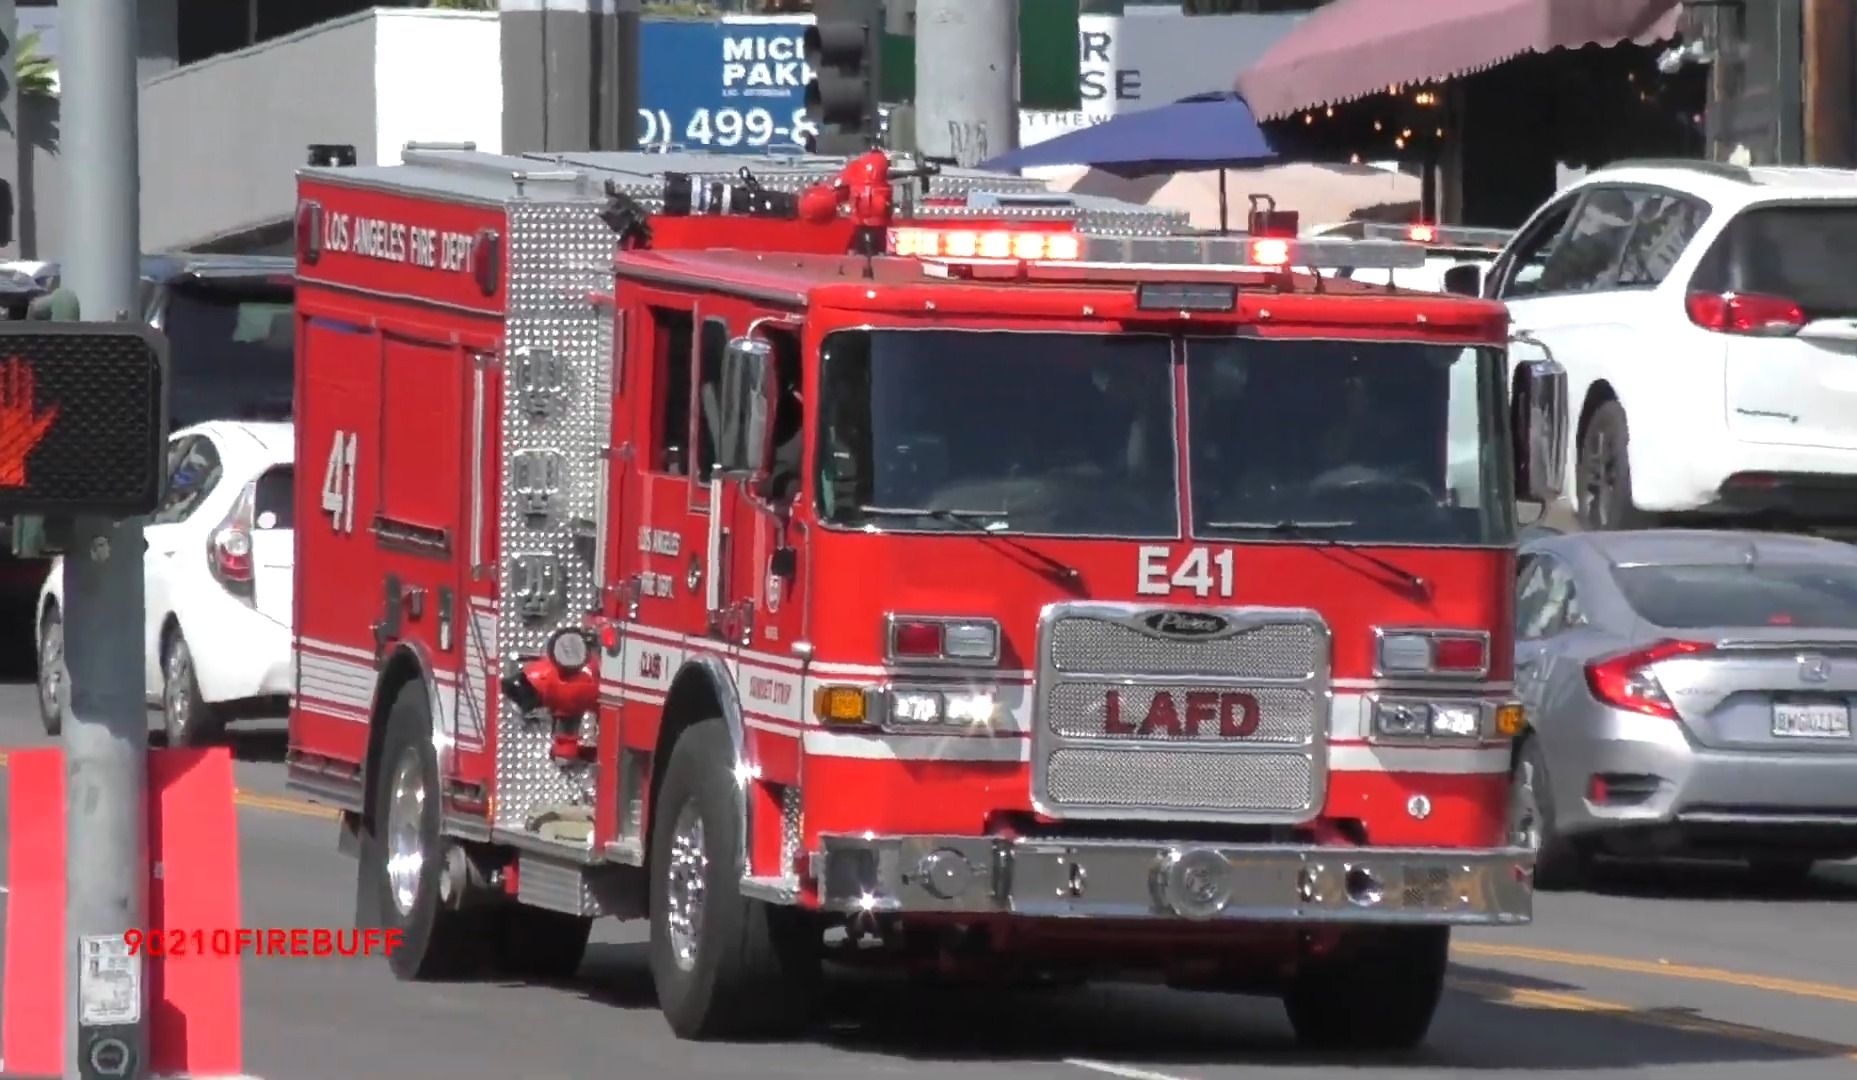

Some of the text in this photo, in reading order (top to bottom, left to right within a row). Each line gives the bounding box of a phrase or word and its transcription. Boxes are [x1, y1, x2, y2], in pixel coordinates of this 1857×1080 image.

[1080, 70, 1141, 100] SE
[325, 211, 474, 273] LOS ANGELES FIRE DEPT
[322, 429, 357, 533] 41
[1138, 545, 1233, 597] E41
[1105, 689, 1260, 737] LAFD
